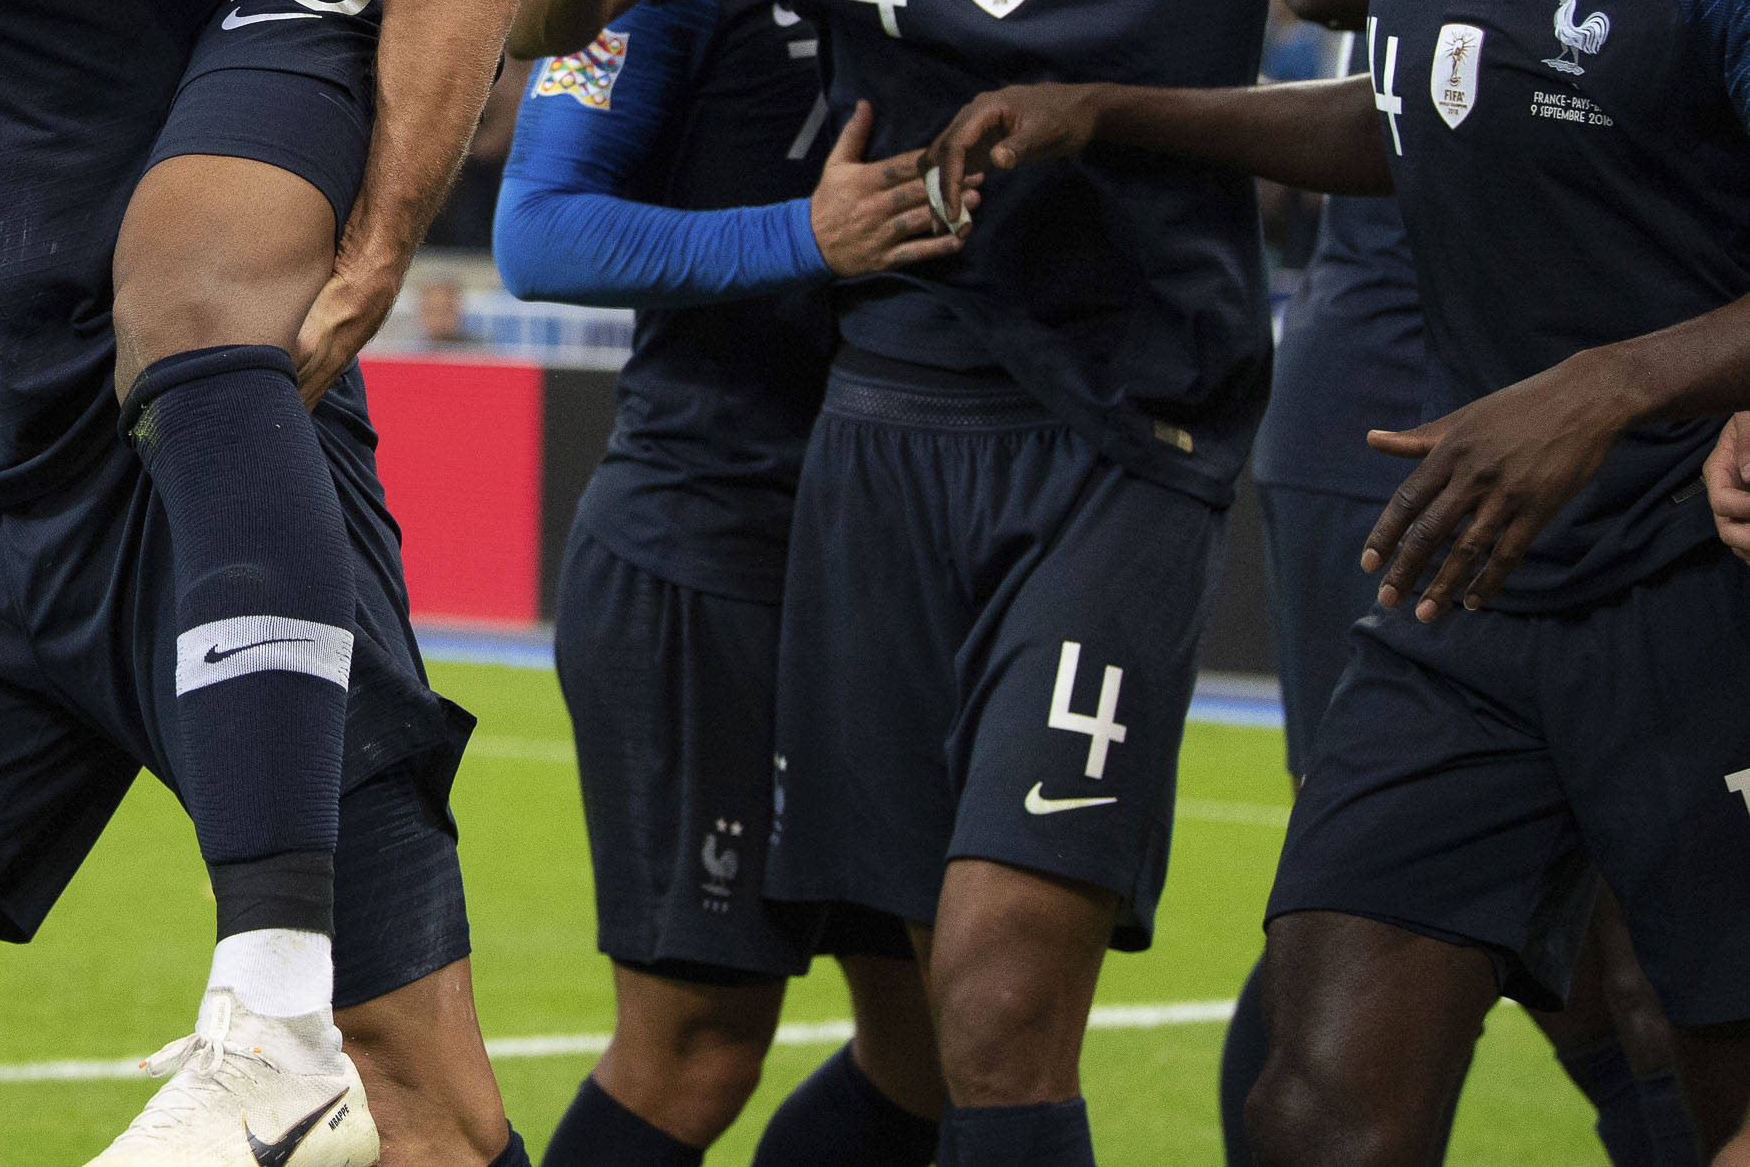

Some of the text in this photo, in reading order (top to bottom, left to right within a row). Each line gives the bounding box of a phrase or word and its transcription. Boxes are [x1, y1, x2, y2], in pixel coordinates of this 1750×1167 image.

[1366, 15, 1403, 156] 4
[1444, 89, 1465, 102] FIFA
[1530, 104, 1538, 116] 9
[1539, 105, 1586, 123] SEPTEMBRE
[1048, 640, 1127, 781] 4
